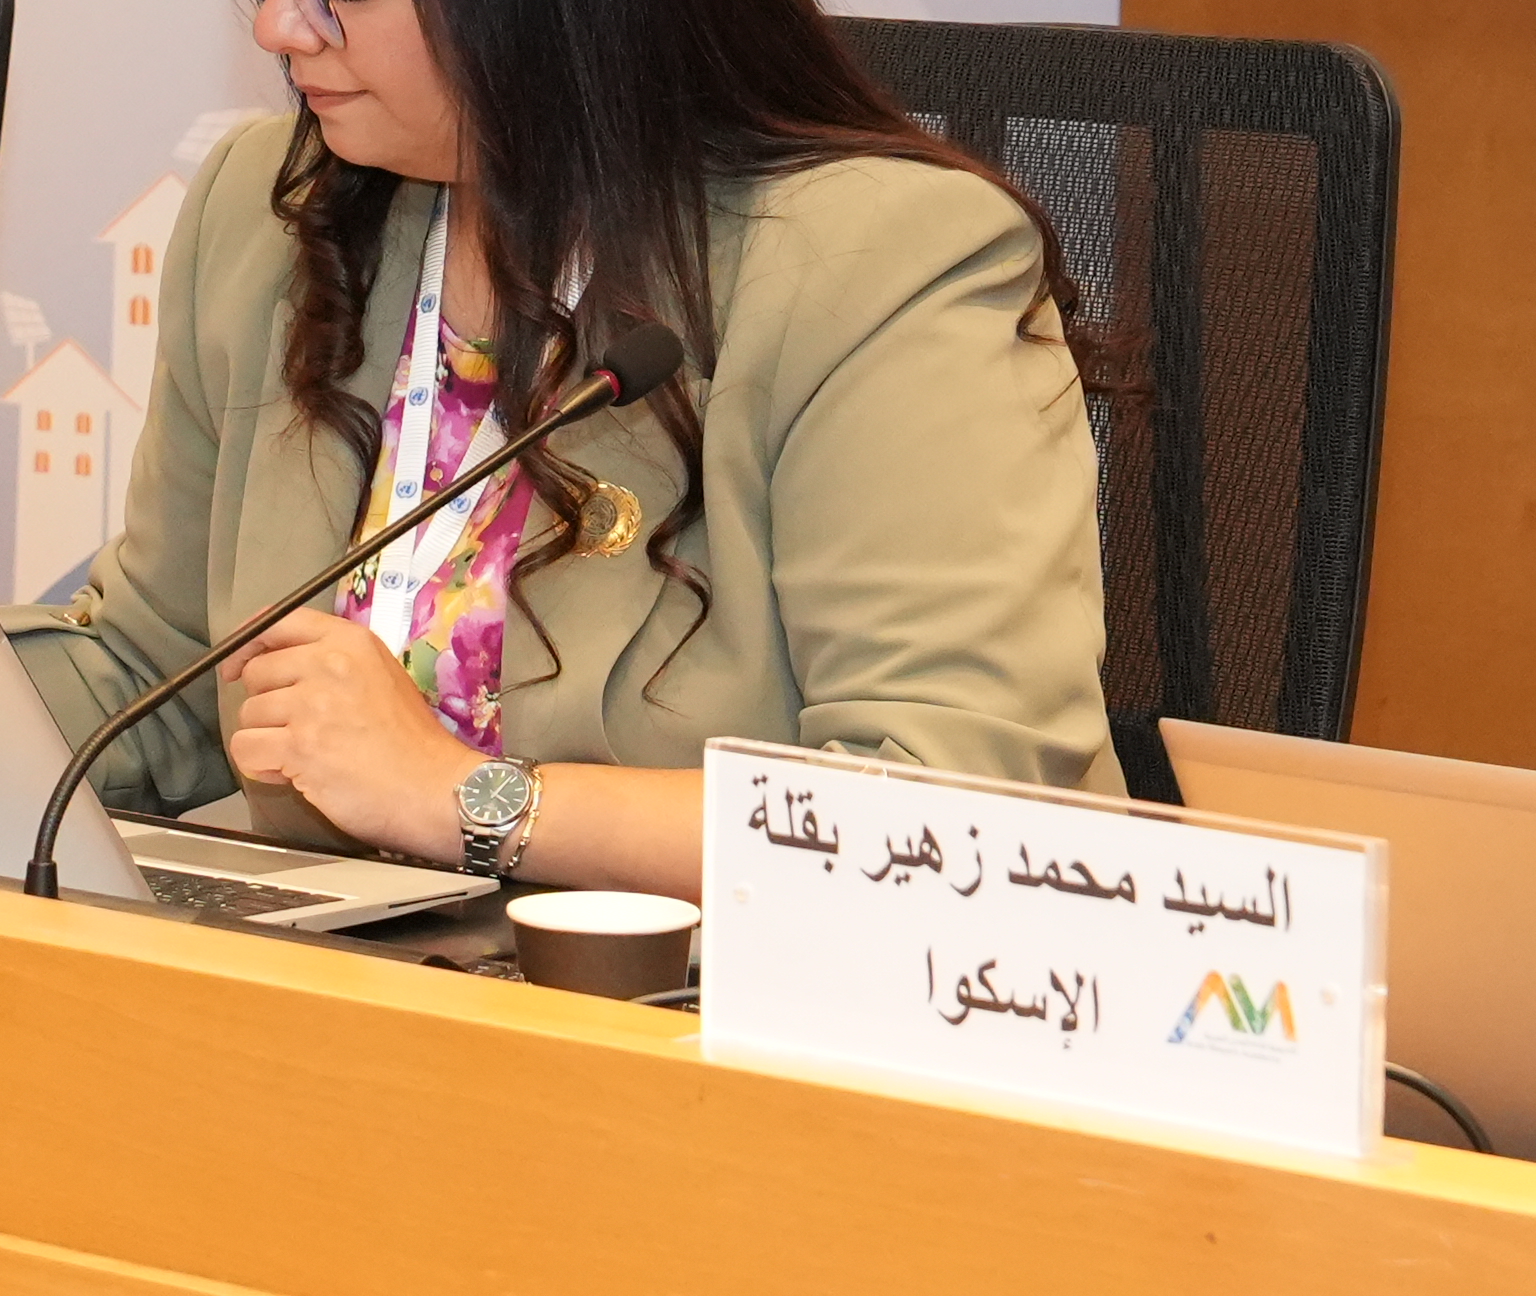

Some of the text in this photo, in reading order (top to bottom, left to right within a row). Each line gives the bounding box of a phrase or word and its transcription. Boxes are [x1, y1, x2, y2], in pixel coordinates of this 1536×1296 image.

[748, 774, 1291, 935] السيد محمد زهير بقلة
[926, 949, 1099, 1049] الإسكوا
